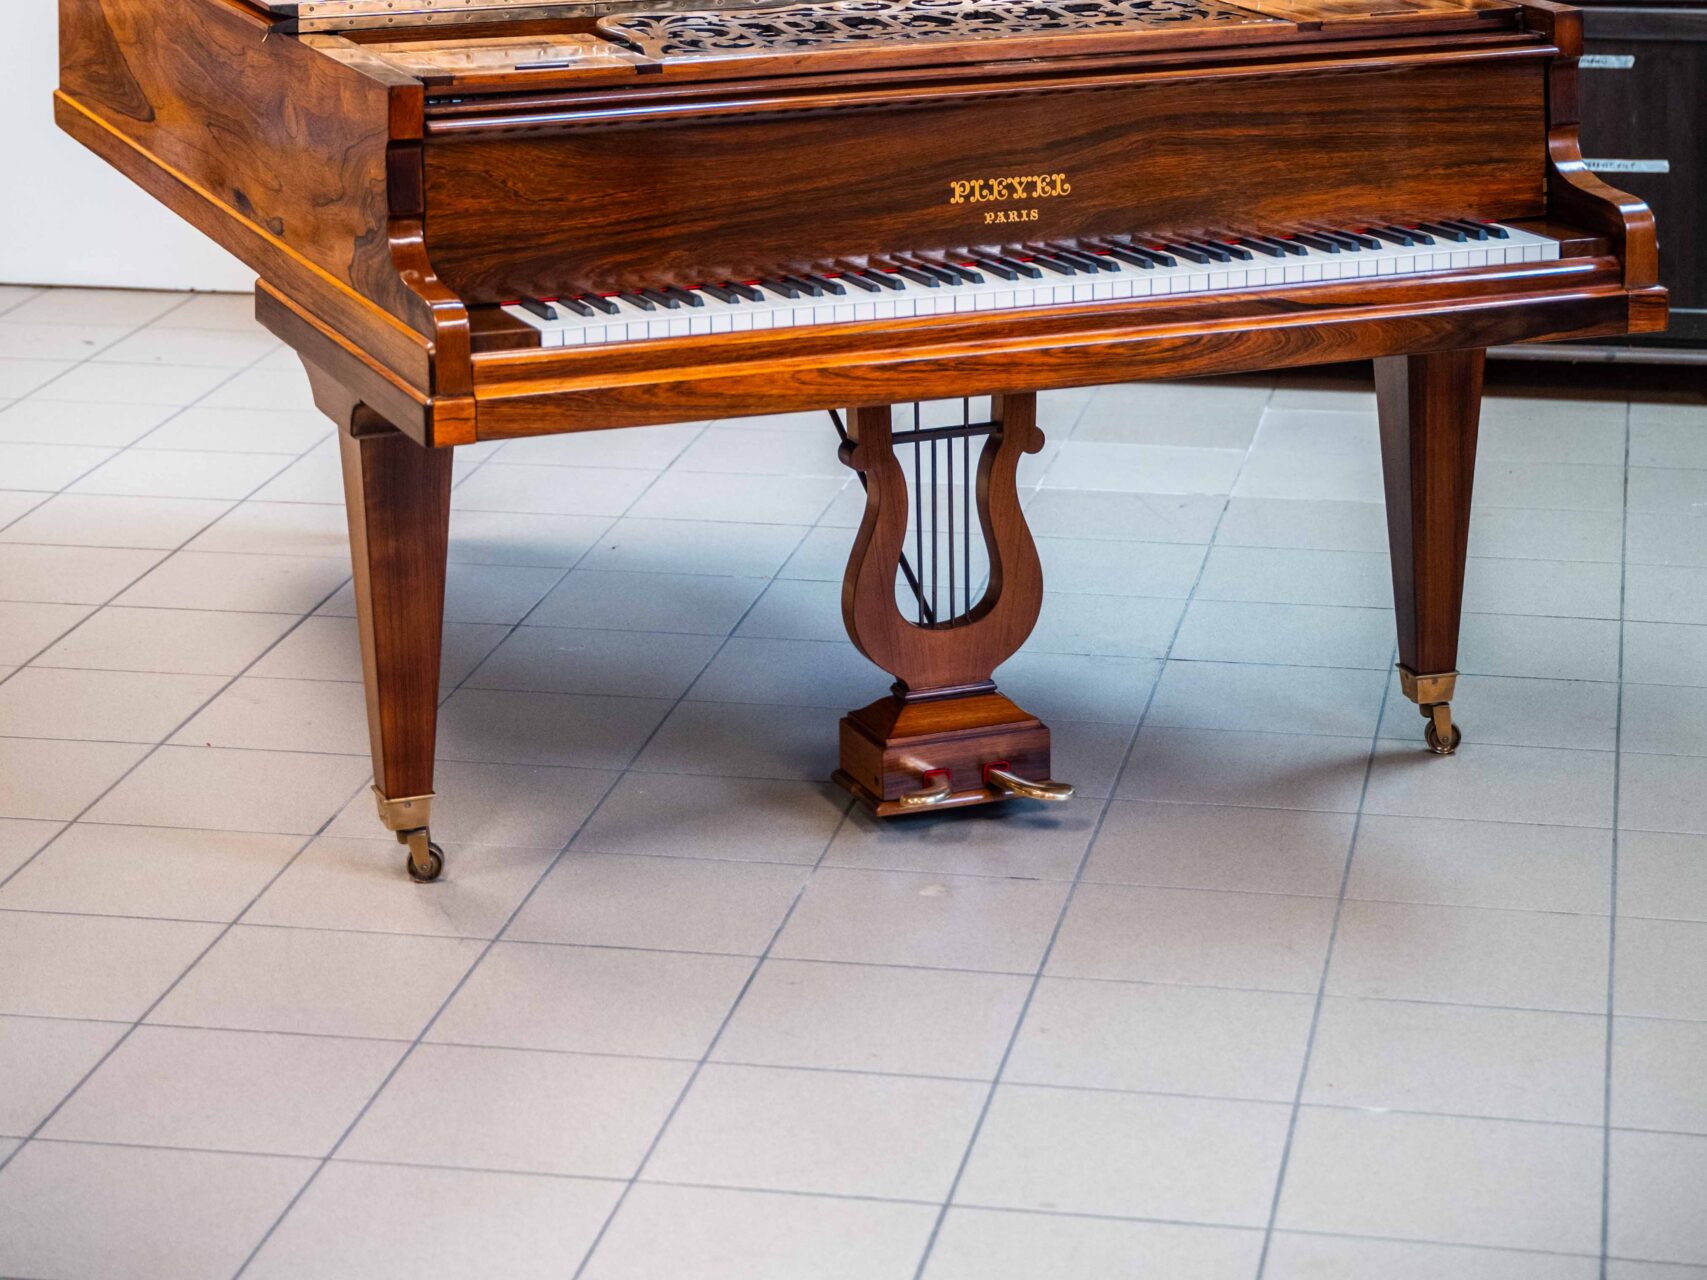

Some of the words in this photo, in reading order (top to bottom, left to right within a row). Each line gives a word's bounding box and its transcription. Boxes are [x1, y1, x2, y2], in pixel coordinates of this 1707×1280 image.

[775, 3, 1103, 36] PLEYEL
[950, 173, 1072, 205] PLEYEL
[984, 209, 1039, 225] PARIS
